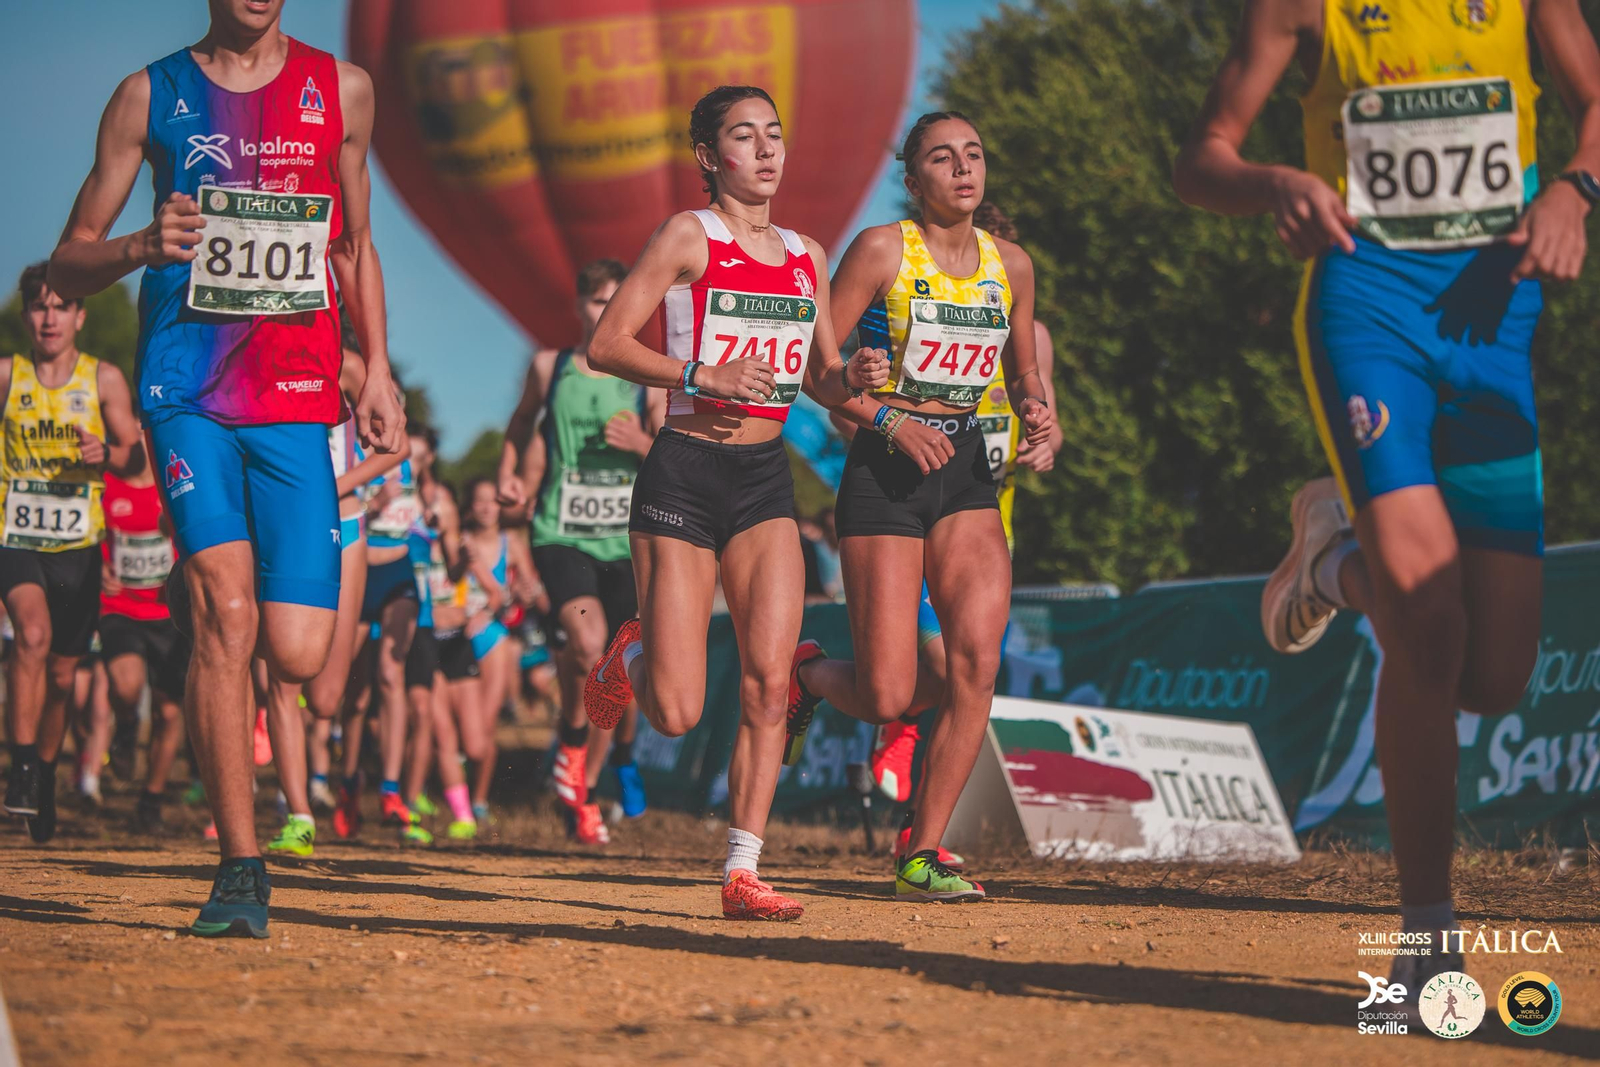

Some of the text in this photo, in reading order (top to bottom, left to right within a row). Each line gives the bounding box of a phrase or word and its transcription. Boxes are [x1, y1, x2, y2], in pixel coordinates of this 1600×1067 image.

[1366, 142, 1511, 200] 8076
[236, 196, 298, 214] ITÁLICA
[206, 236, 315, 281] 8101
[744, 297, 792, 314] ITÁLICA
[944, 307, 988, 321] ITÁLICA
[715, 333, 803, 375] 7416
[917, 339, 998, 378] 7478
[288, 380, 324, 390] TAKELOT
[21, 420, 81, 440] LaMafi
[15, 505, 82, 533] 8112
[568, 496, 630, 519] 6055
[1152, 757, 1282, 826] ITÁLICA
